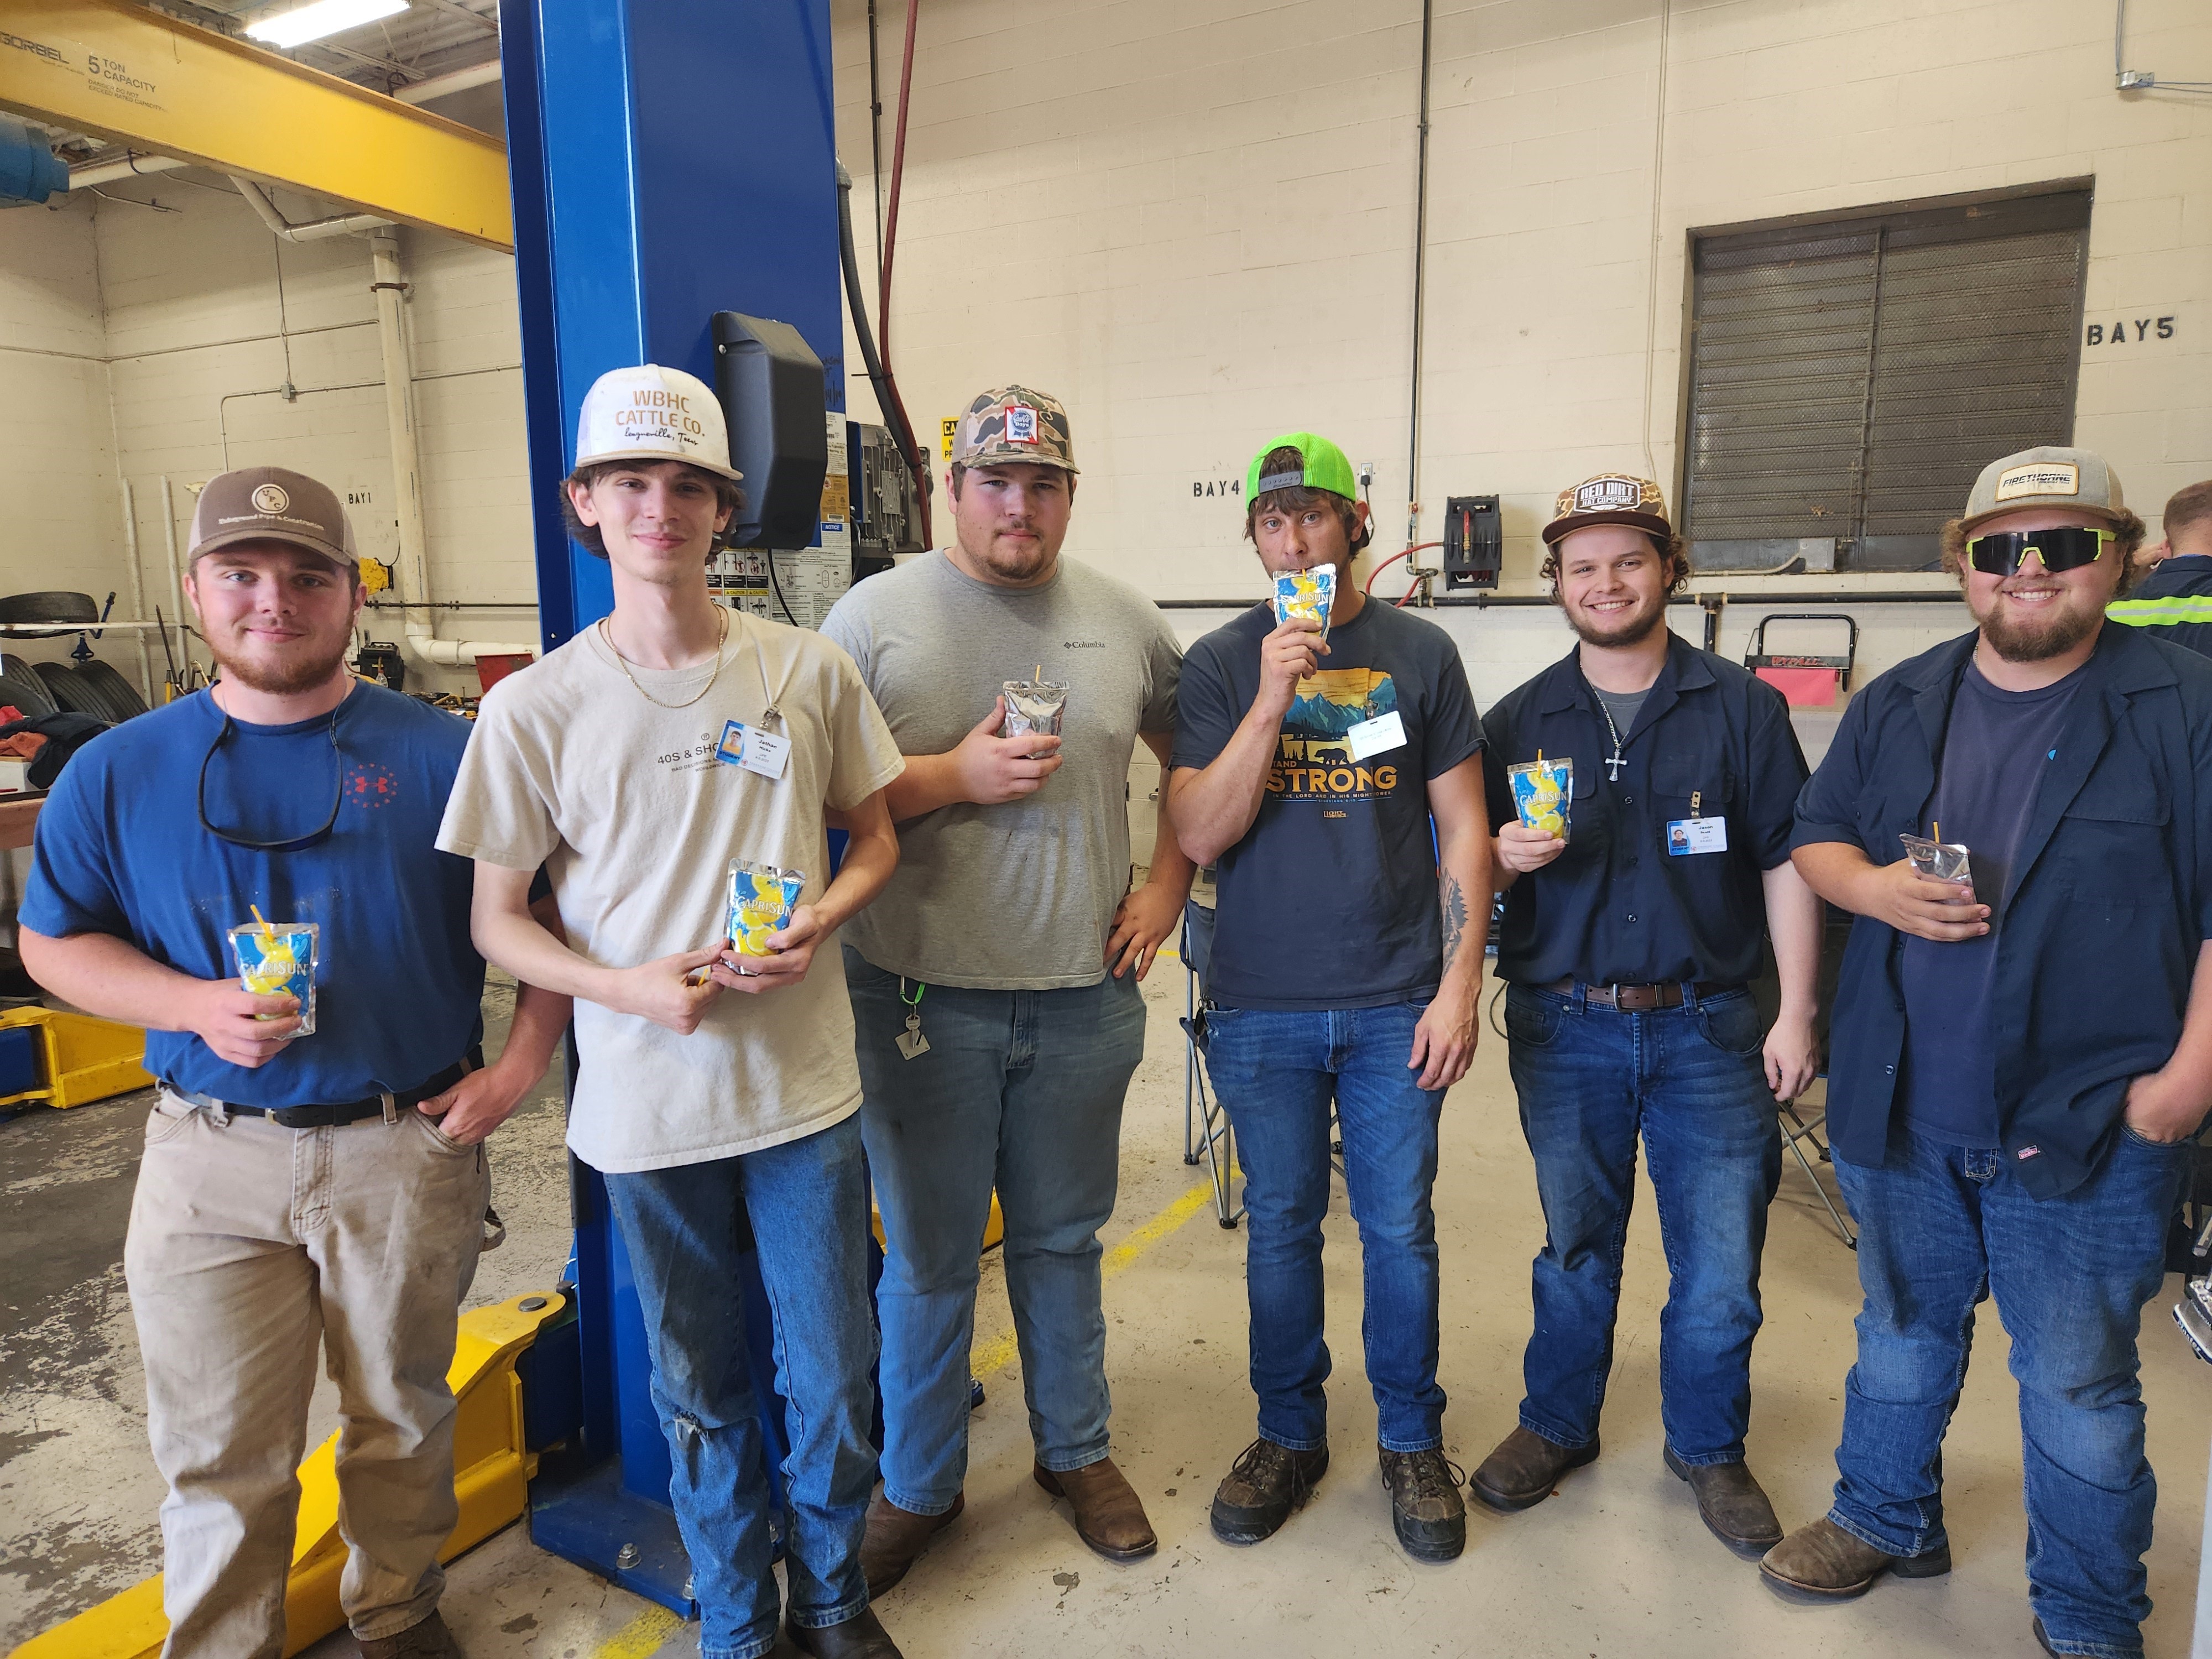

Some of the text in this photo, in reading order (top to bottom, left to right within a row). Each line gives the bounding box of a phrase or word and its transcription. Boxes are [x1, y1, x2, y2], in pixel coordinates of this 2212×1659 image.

[88, 55, 100, 74] 5
[103, 59, 126, 73] TON
[103, 70, 156, 92] CAPACITY
[633, 390, 690, 413] WBHC
[615, 410, 705, 436] CATTLE CO.
[2002, 473, 2072, 487] FIRETHORNE
[1580, 482, 1635, 500] RED DIRT
[758, 740, 777, 749] Jathan
[658, 752, 681, 764] 40S
[684, 750, 692, 758] &
[719, 751, 740, 760] STUDENT
[1265, 765, 1398, 792] STRONG
